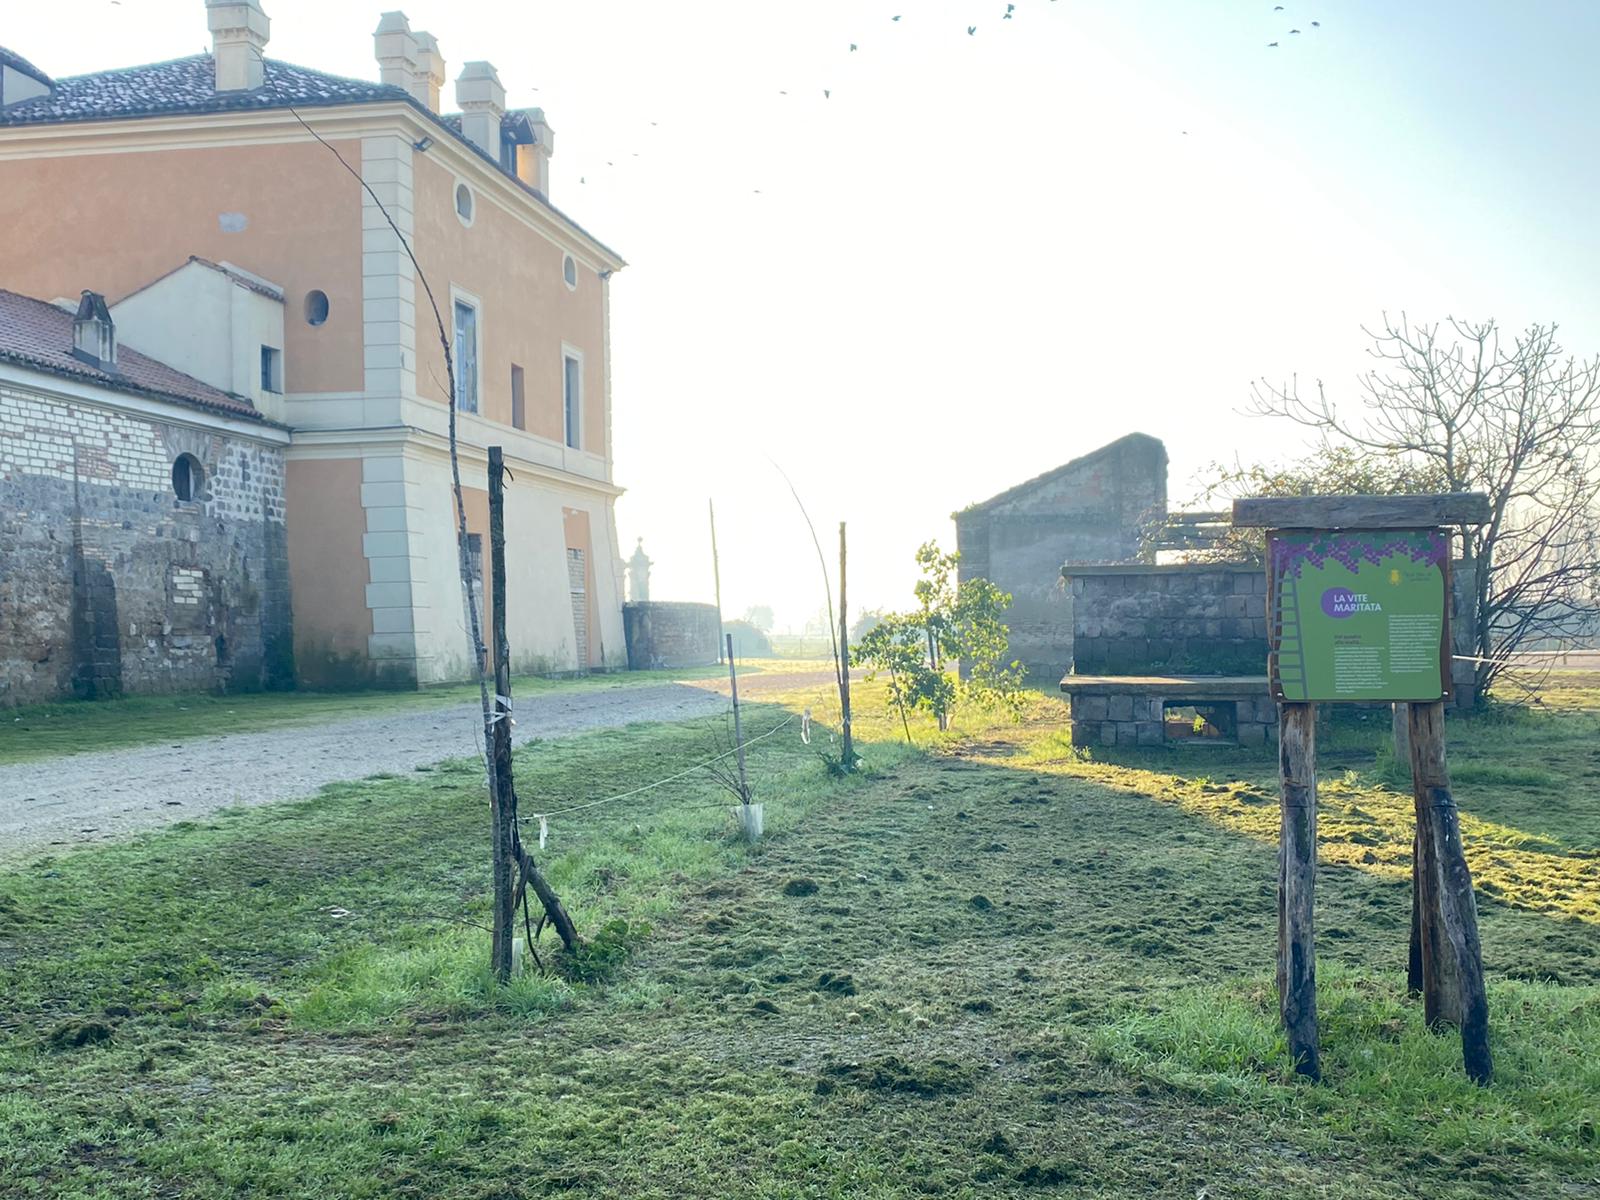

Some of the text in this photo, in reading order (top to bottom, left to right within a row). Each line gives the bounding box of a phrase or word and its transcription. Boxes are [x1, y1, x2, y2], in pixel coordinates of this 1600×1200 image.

[1334, 594, 1368, 602] LA VITE
[1334, 603, 1382, 612] MARITATA
